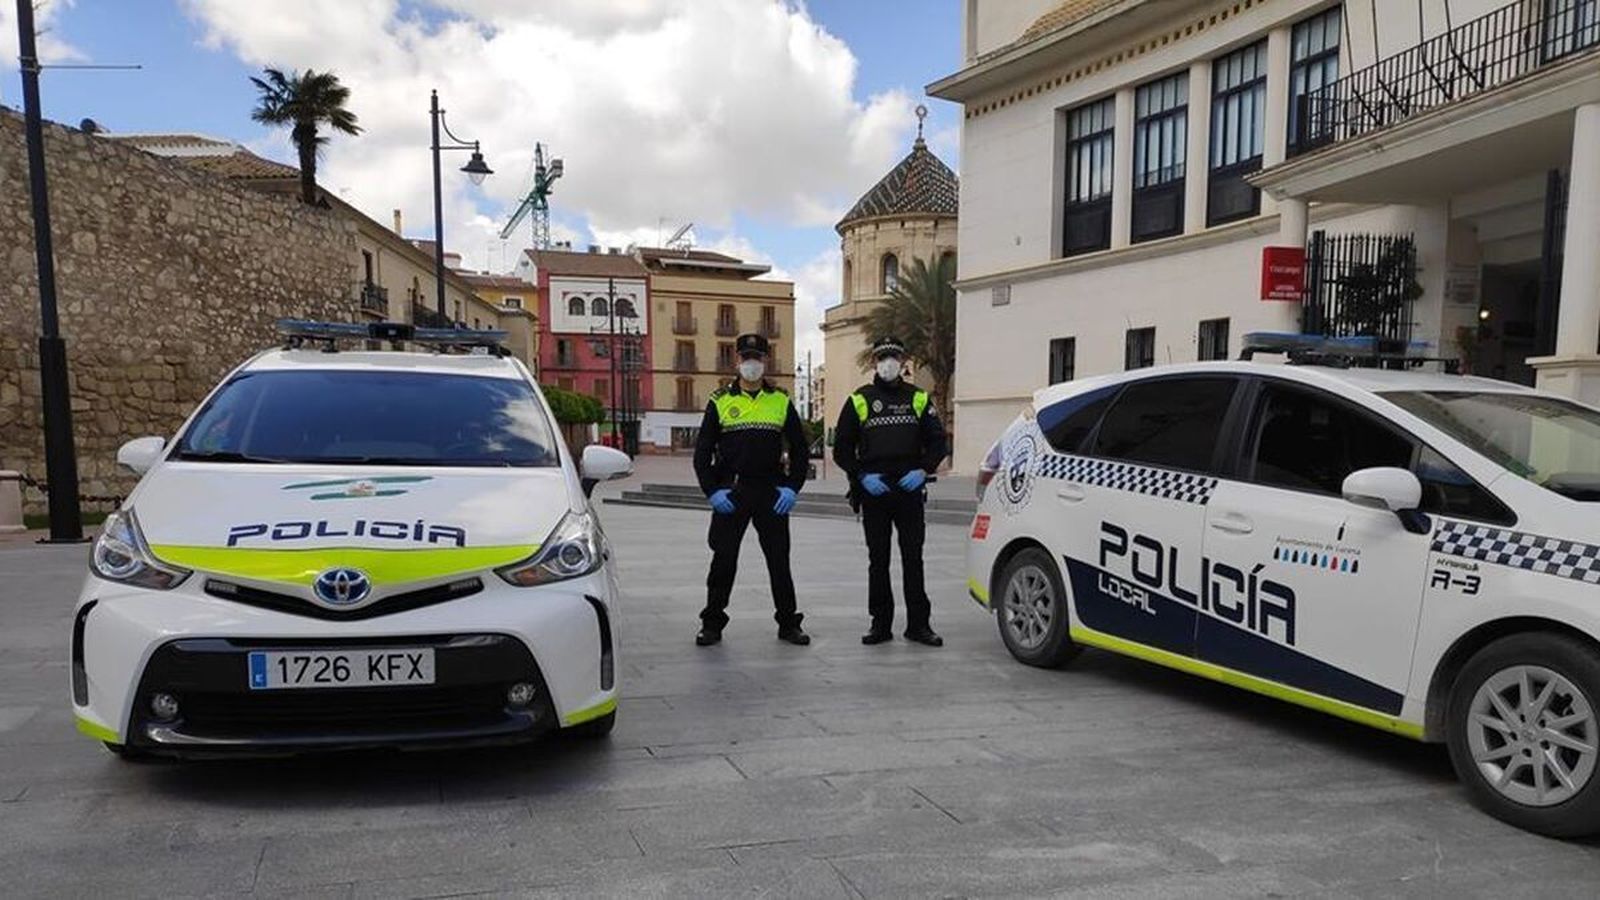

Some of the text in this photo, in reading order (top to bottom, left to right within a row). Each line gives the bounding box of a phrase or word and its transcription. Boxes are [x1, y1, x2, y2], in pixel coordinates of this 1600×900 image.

[226, 519, 466, 547] POLICÍA
[1098, 572, 1157, 616] LOCAL
[1099, 520, 1296, 646] POLICÍA
[277, 653, 424, 684] 1726 KFX
